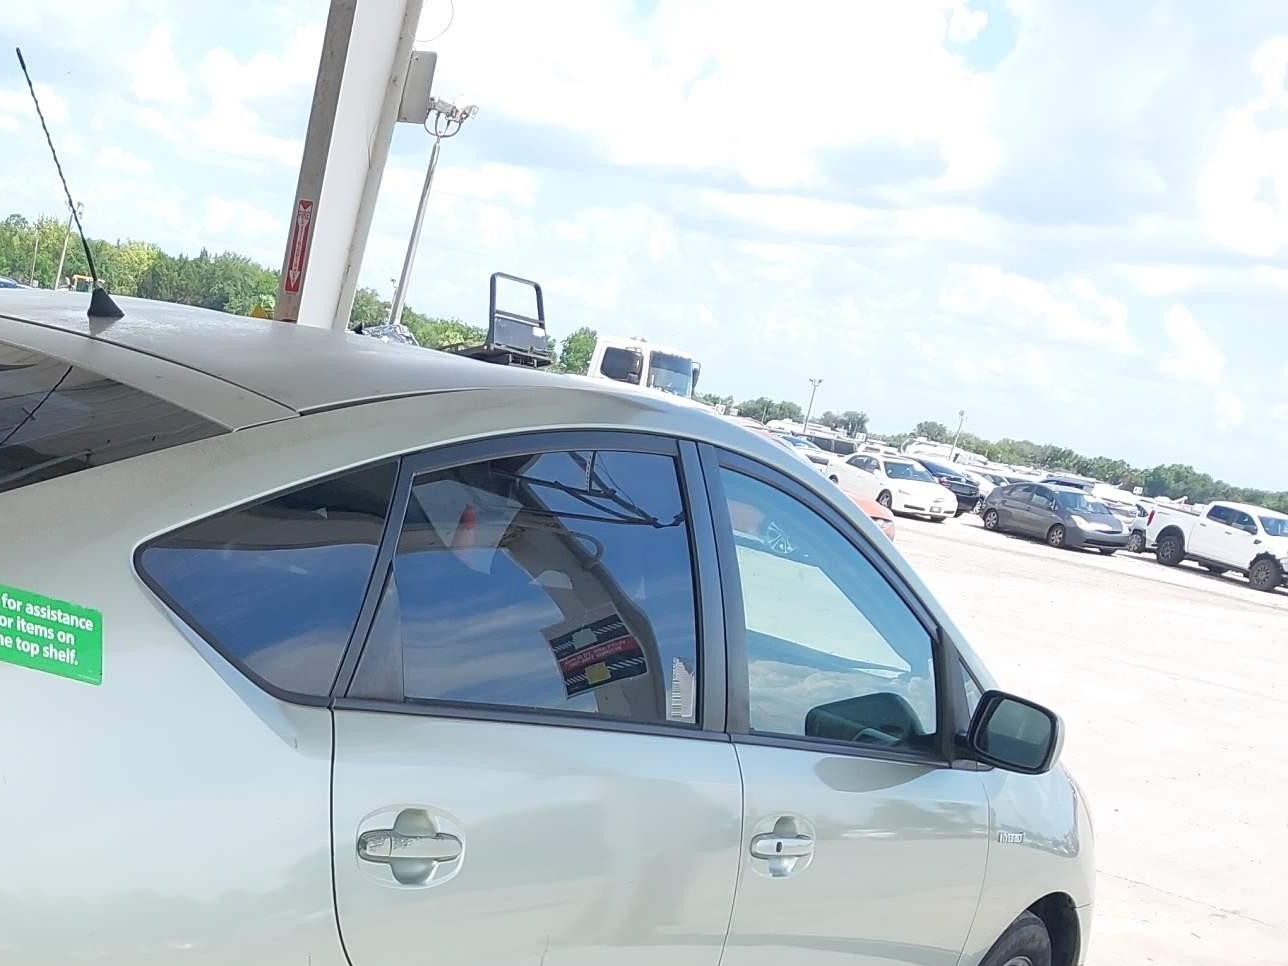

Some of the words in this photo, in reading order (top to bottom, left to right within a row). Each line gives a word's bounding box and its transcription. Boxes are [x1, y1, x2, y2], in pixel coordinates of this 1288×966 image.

[1, 593, 23, 612] for
[25, 603, 94, 631] assistance
[16, 616, 55, 640] items
[57, 630, 75, 646] on
[15, 637, 40, 657] top
[42, 644, 79, 666] shelf.
